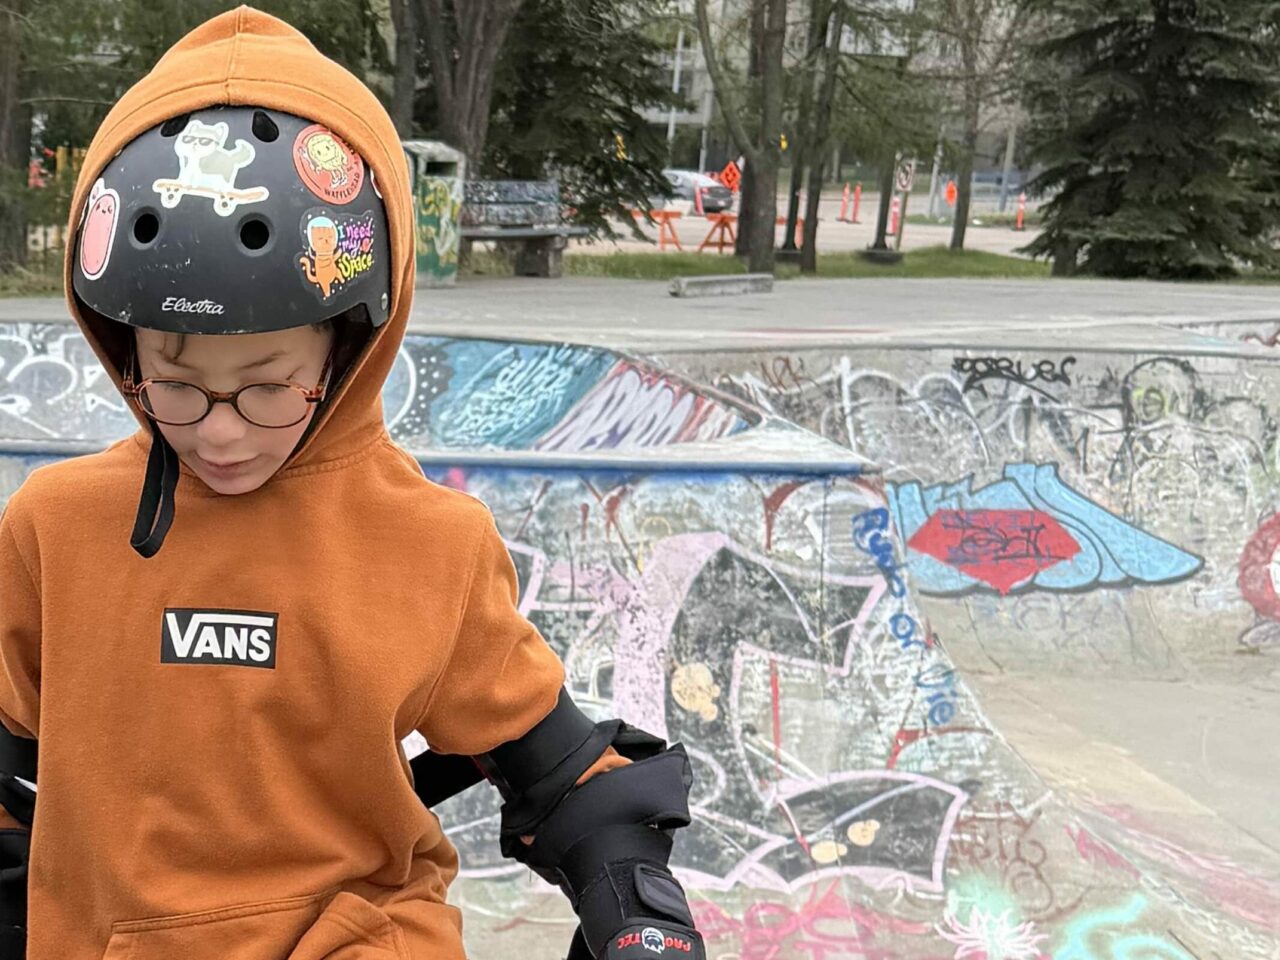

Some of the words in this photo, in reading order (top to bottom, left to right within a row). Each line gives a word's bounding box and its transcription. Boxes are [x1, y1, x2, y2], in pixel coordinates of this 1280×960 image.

[338, 225, 346, 239] I
[346, 218, 373, 239] need
[161, 297, 225, 315] Electra
[165, 612, 275, 662] VANS
[617, 932, 641, 950] TEC
[664, 936, 692, 953] PRO
